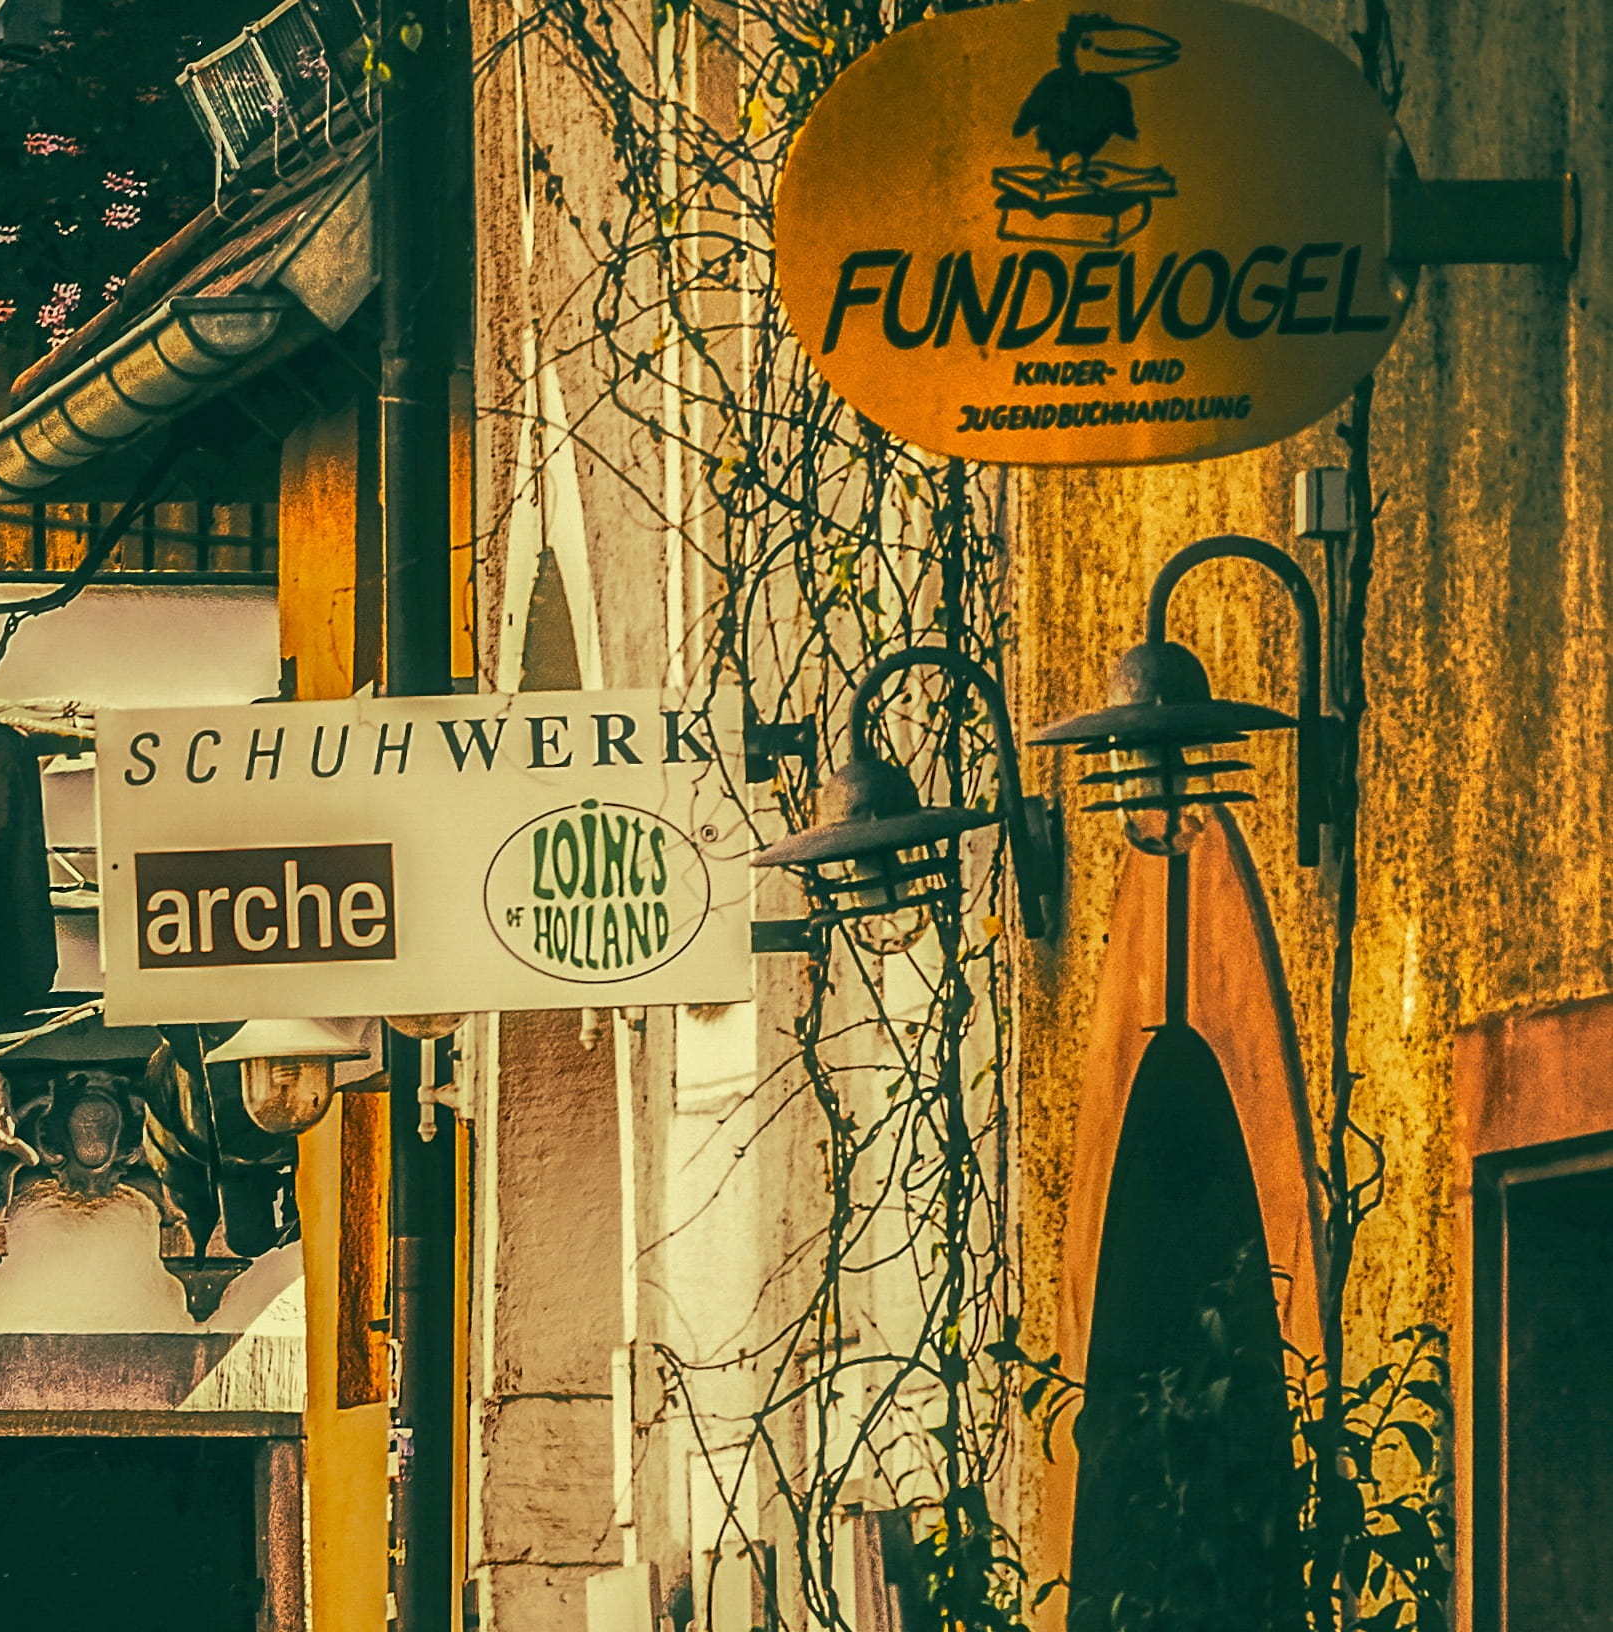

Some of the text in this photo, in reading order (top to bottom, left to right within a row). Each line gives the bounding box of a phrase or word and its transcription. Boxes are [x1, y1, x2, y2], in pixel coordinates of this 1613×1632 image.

[822, 243, 1391, 354] FUNDEVOGEL
[1014, 359, 1185, 386] KINDER- UND
[957, 395, 1253, 432] JUGENDBUCHHANDLUNG
[145, 860, 388, 956] arche
[506, 906, 524, 928] OF
[533, 902, 668, 971] HOLLAND
